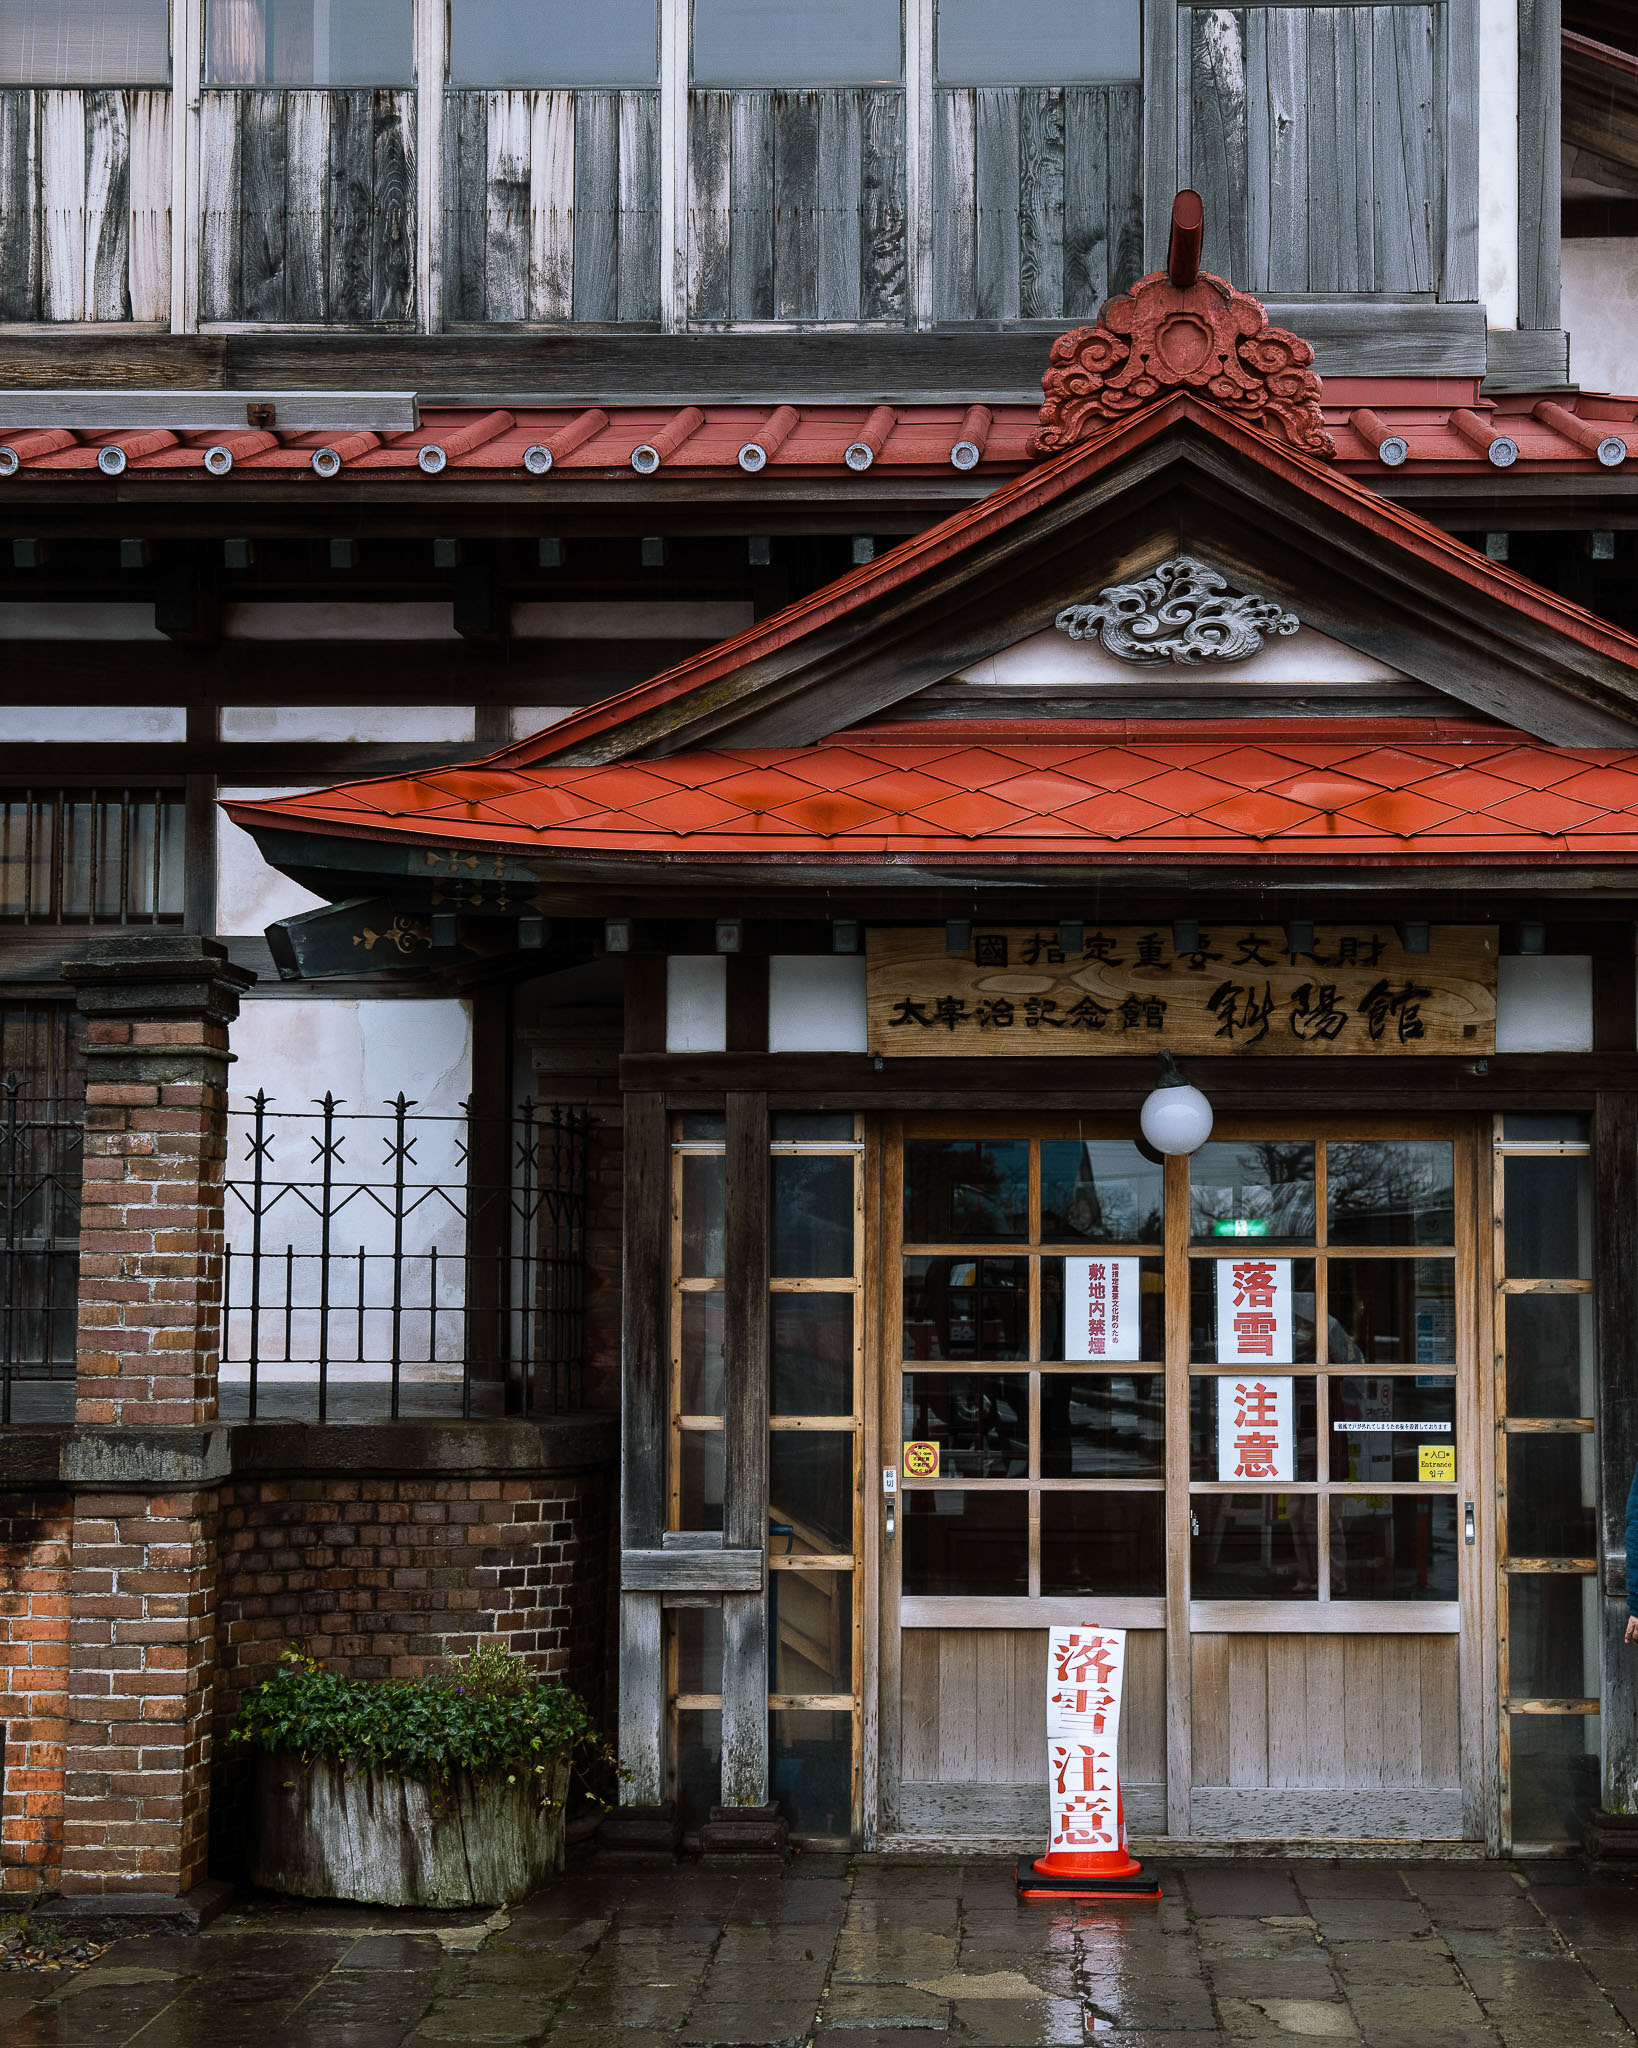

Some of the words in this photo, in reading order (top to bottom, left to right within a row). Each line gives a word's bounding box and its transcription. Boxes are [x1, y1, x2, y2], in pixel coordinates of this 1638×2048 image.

[889, 994, 1168, 1031] 太宰治記念館
[1206, 978, 1432, 1049] 斜陽館
[1088, 1263, 1106, 1354] 敷地内禁煙
[1111, 1263, 1119, 1344] 国指定重要文化財のため
[1232, 1261, 1277, 1356] 落雪
[1233, 1382, 1279, 1477] 注意
[1051, 1634, 1120, 1845] 落雪注意
